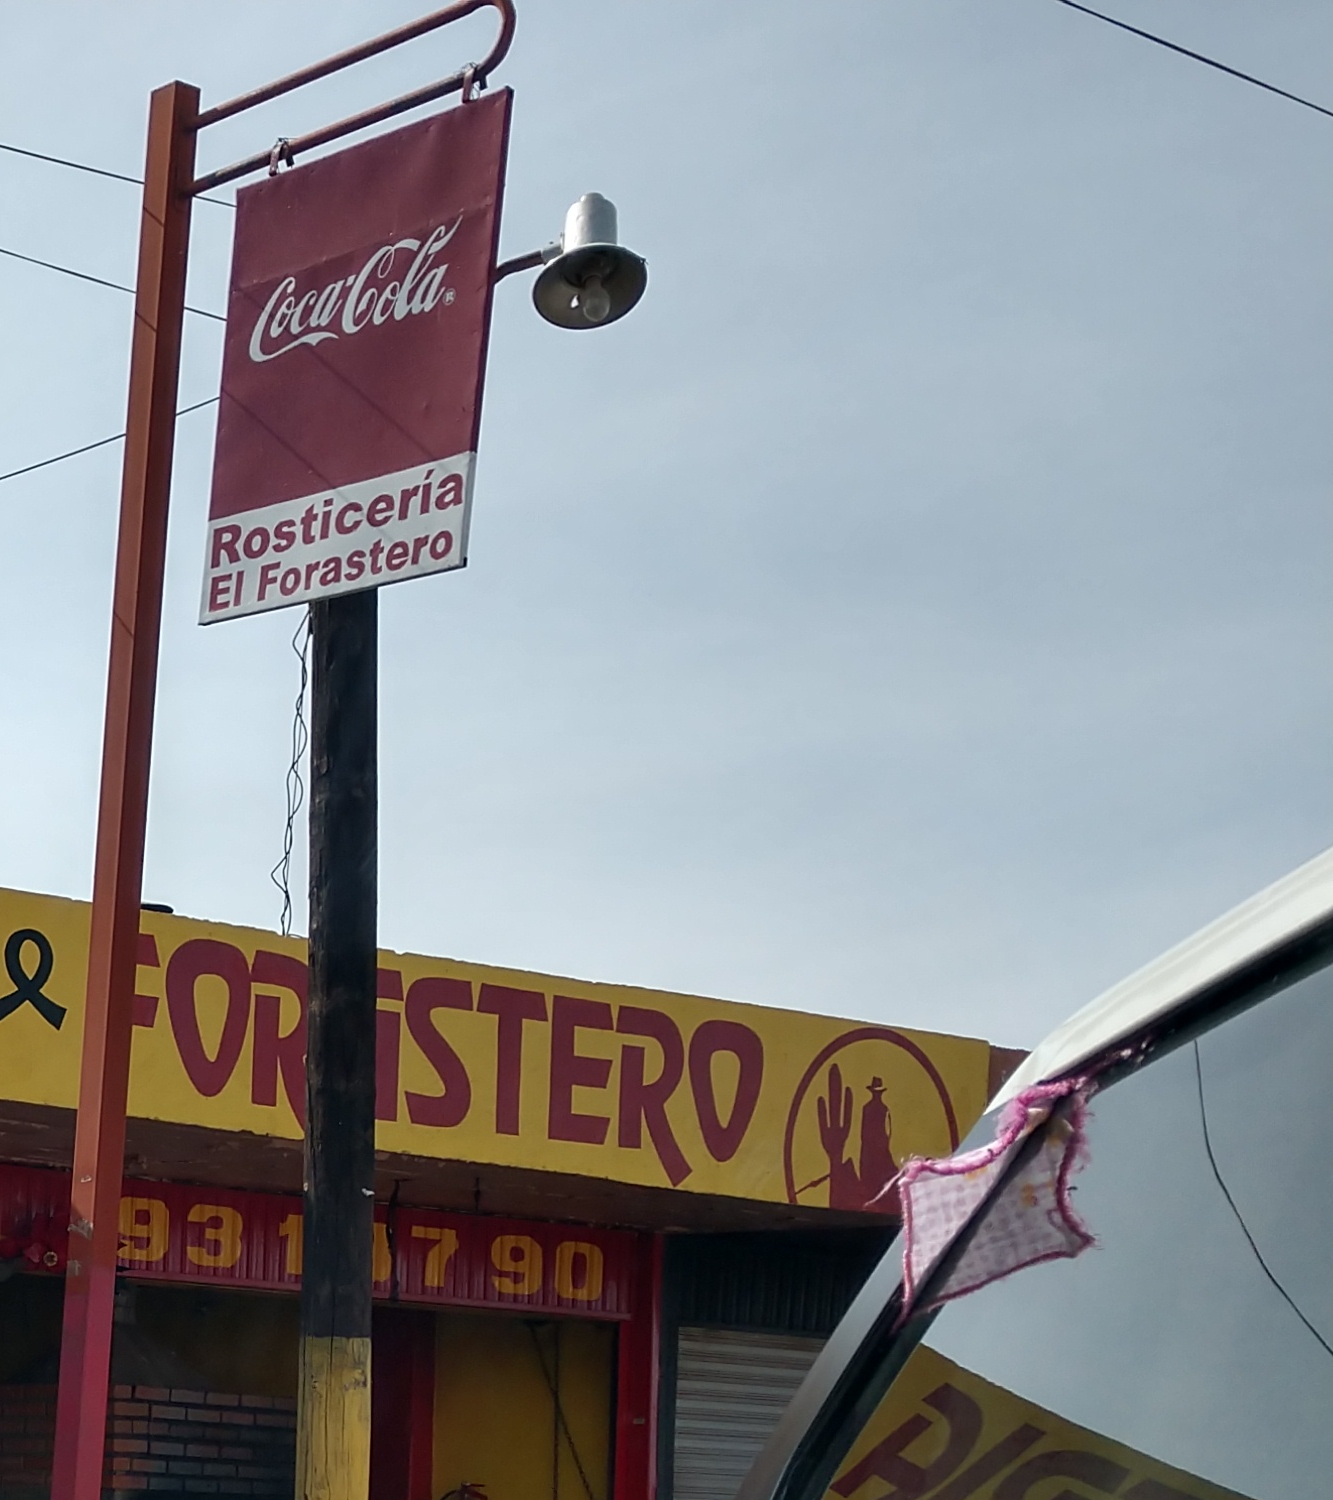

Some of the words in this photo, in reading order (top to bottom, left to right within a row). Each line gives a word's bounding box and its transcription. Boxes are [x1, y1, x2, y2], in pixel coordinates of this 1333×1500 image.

[248, 215, 464, 364] Coca-Cola
[208, 572, 244, 614] El
[257, 526, 455, 602] Forastero
[211, 467, 464, 571] Rosticería
[131, 930, 765, 1187] ORSTERO
